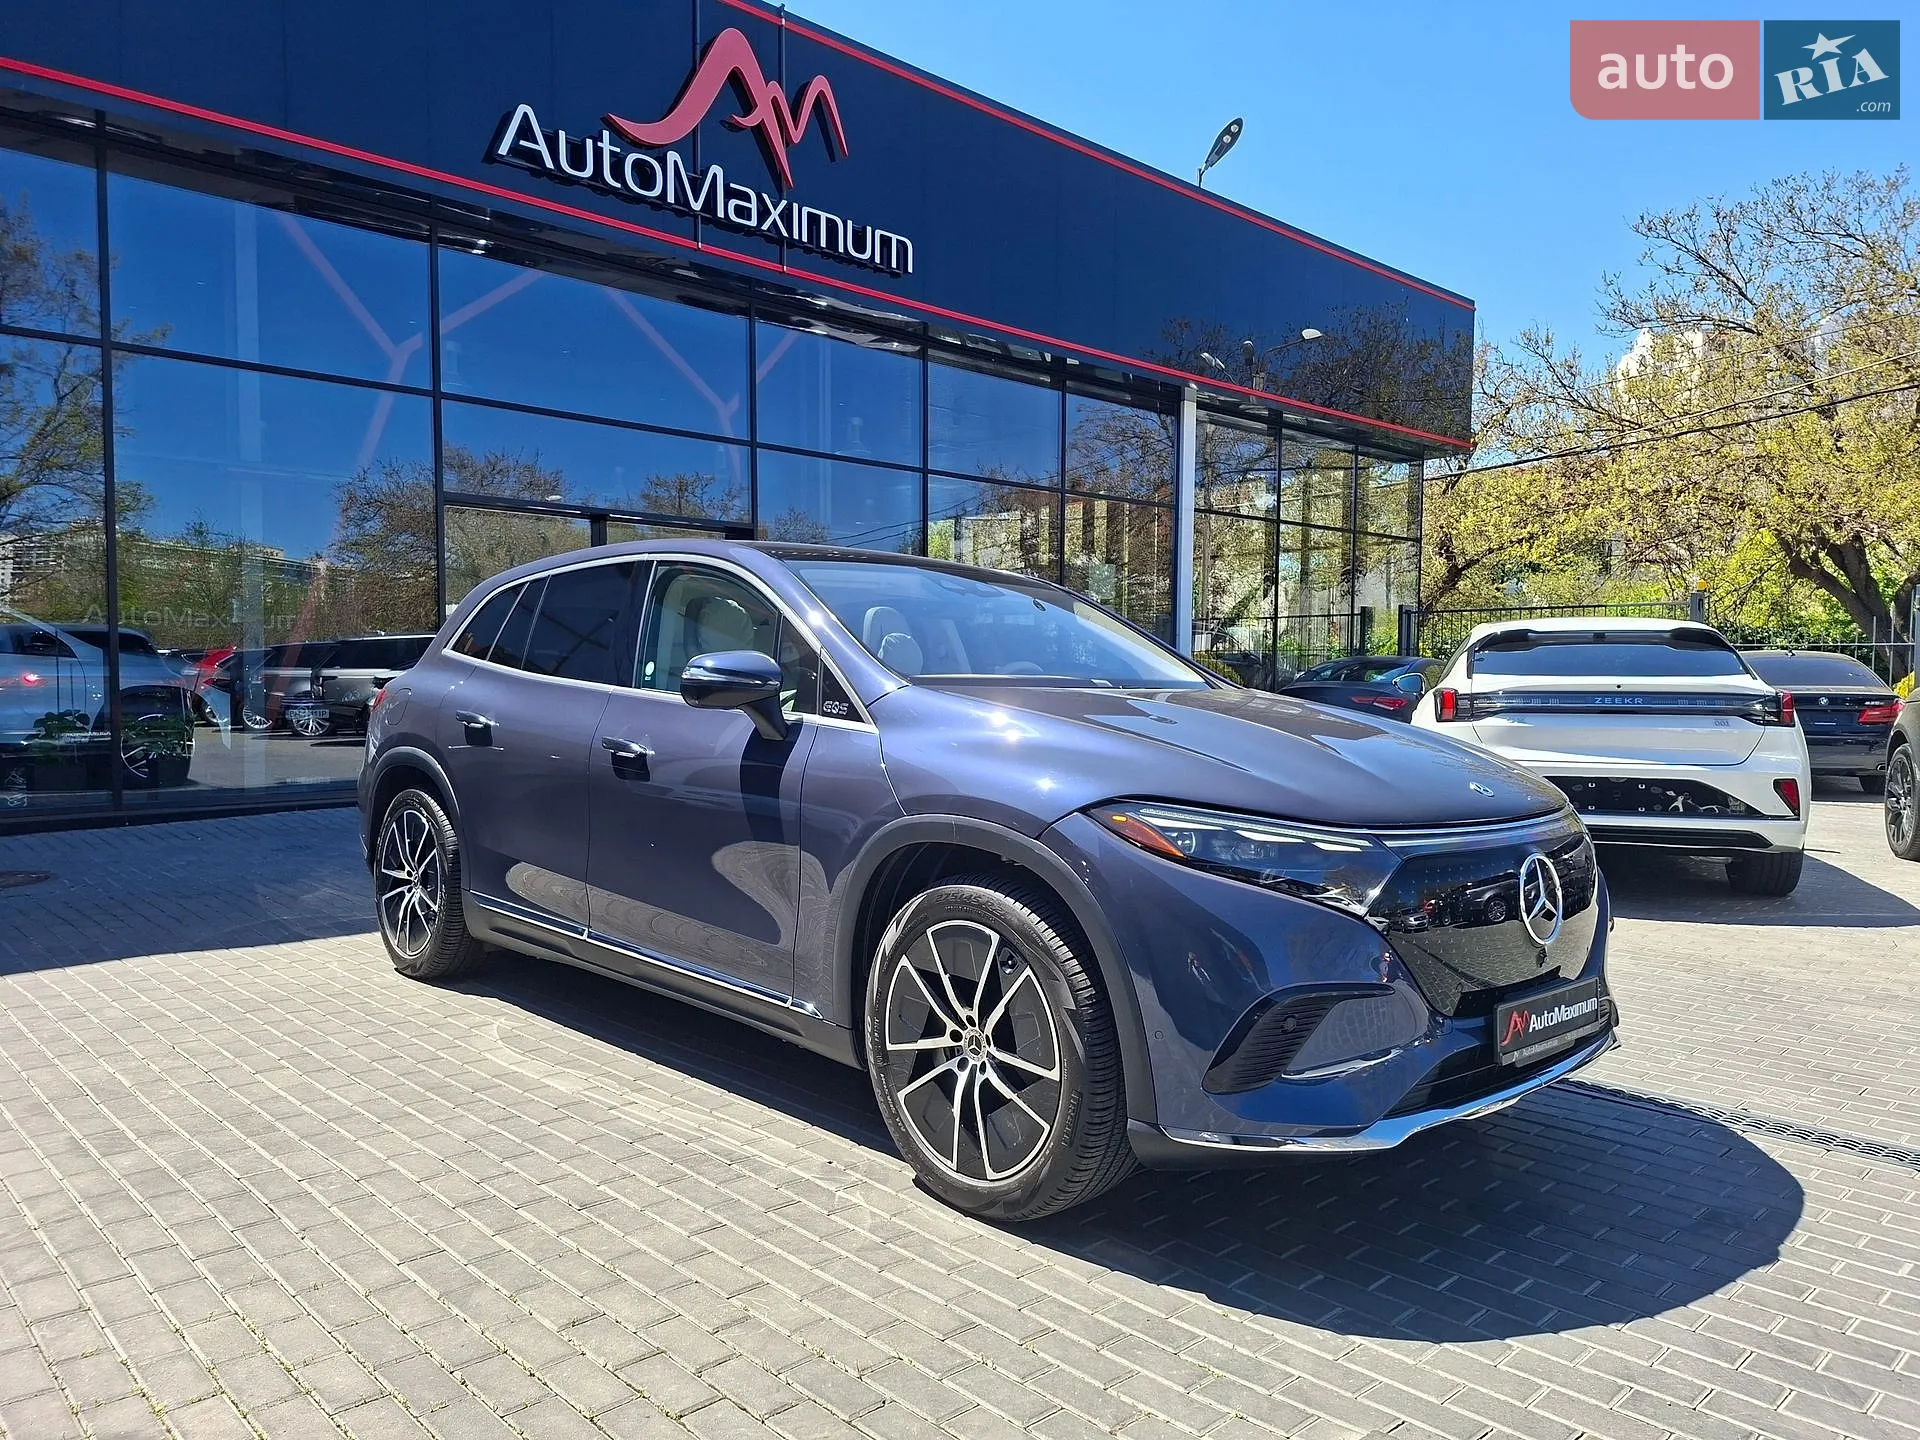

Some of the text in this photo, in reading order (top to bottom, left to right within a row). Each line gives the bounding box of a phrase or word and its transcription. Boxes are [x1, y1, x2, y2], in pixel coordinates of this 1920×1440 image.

[497, 103, 914, 274] AutoMaximum
[823, 700, 849, 716] EQS
[1594, 697, 1644, 705] ZEEKR
[1529, 997, 1598, 1033] AutoMaximum
